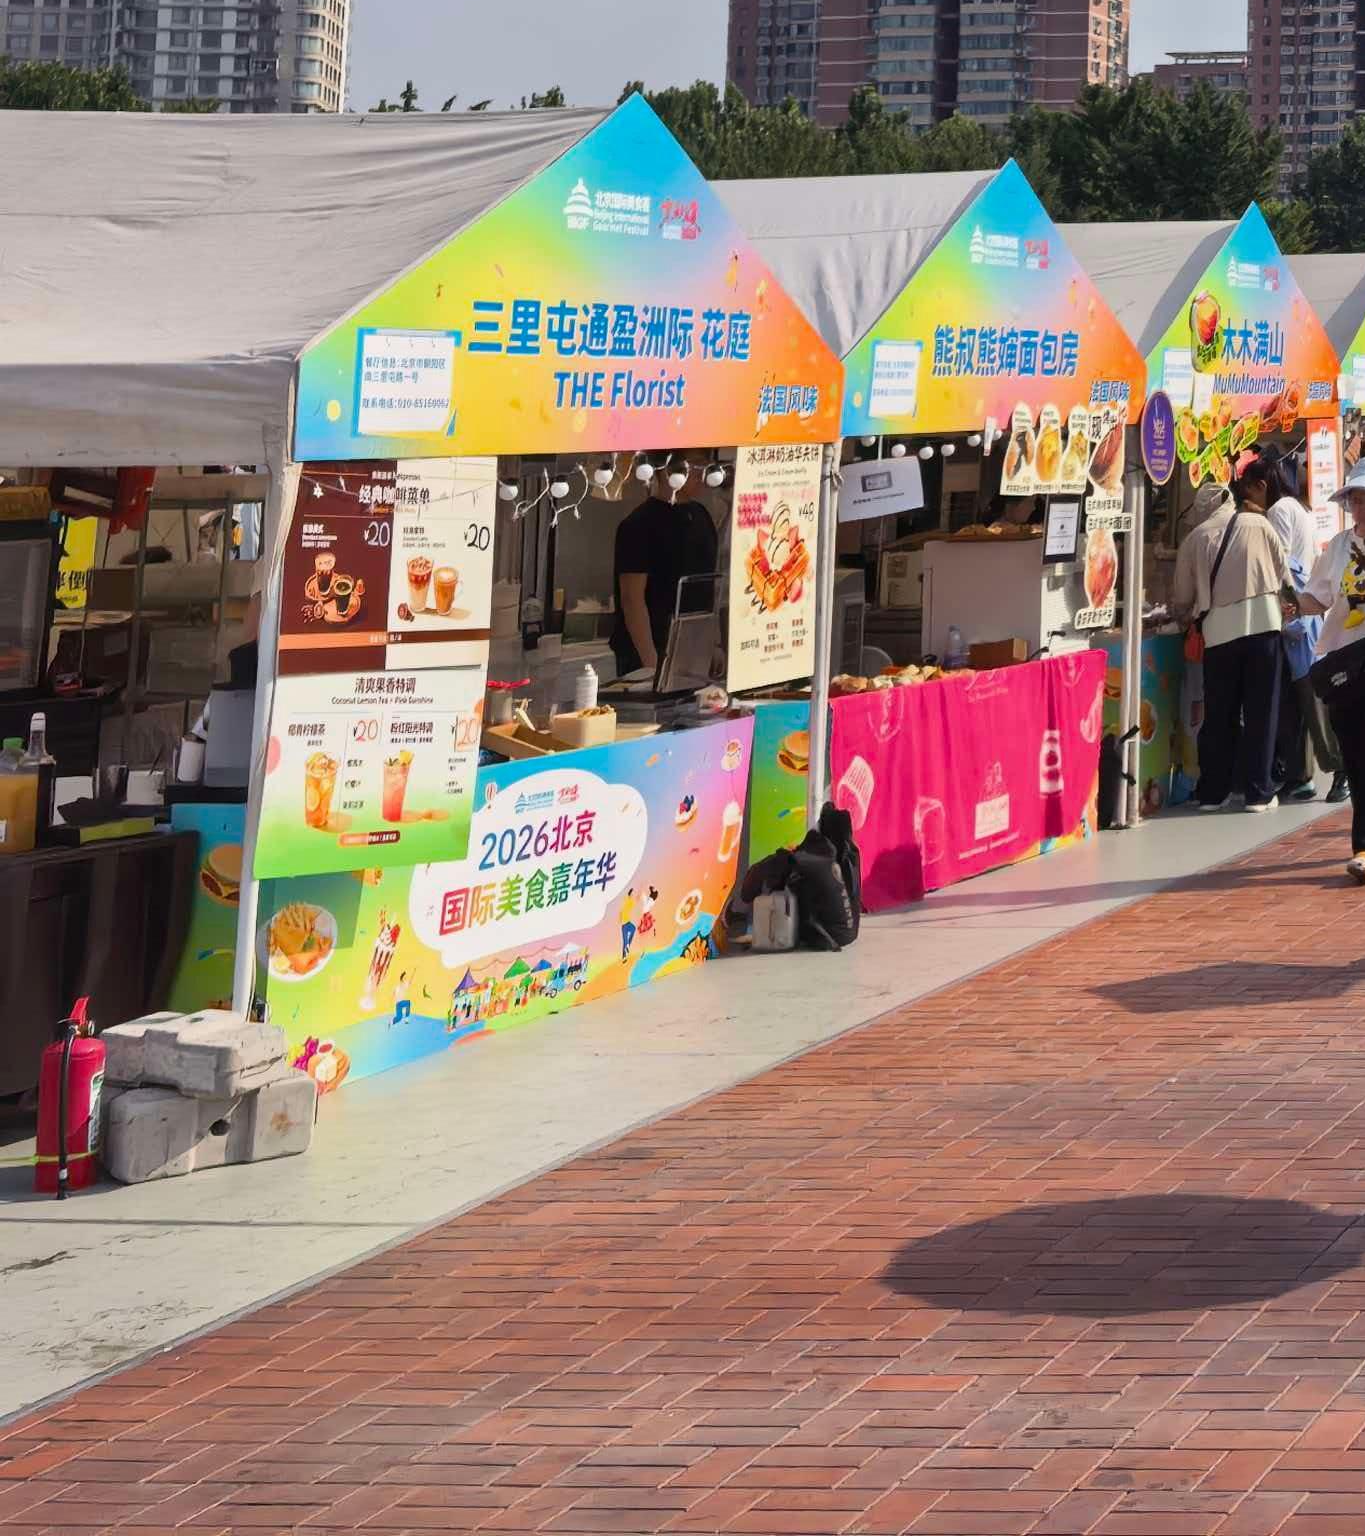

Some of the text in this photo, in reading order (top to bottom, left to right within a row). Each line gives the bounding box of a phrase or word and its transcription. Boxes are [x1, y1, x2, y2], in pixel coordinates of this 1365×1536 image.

[468, 299, 753, 362] 三里屯通盈洲际 花庭
[553, 371, 686, 408] THE Florist
[358, 484, 431, 505] 经典咖啡菜单
[364, 521, 391, 548] ¥20
[463, 523, 491, 551] ¥20
[354, 677, 416, 695] 清爽果香特调
[353, 719, 379, 742] ¥20
[480, 810, 597, 871] 2026北京
[438, 851, 618, 937] 国际美食嘉年华
